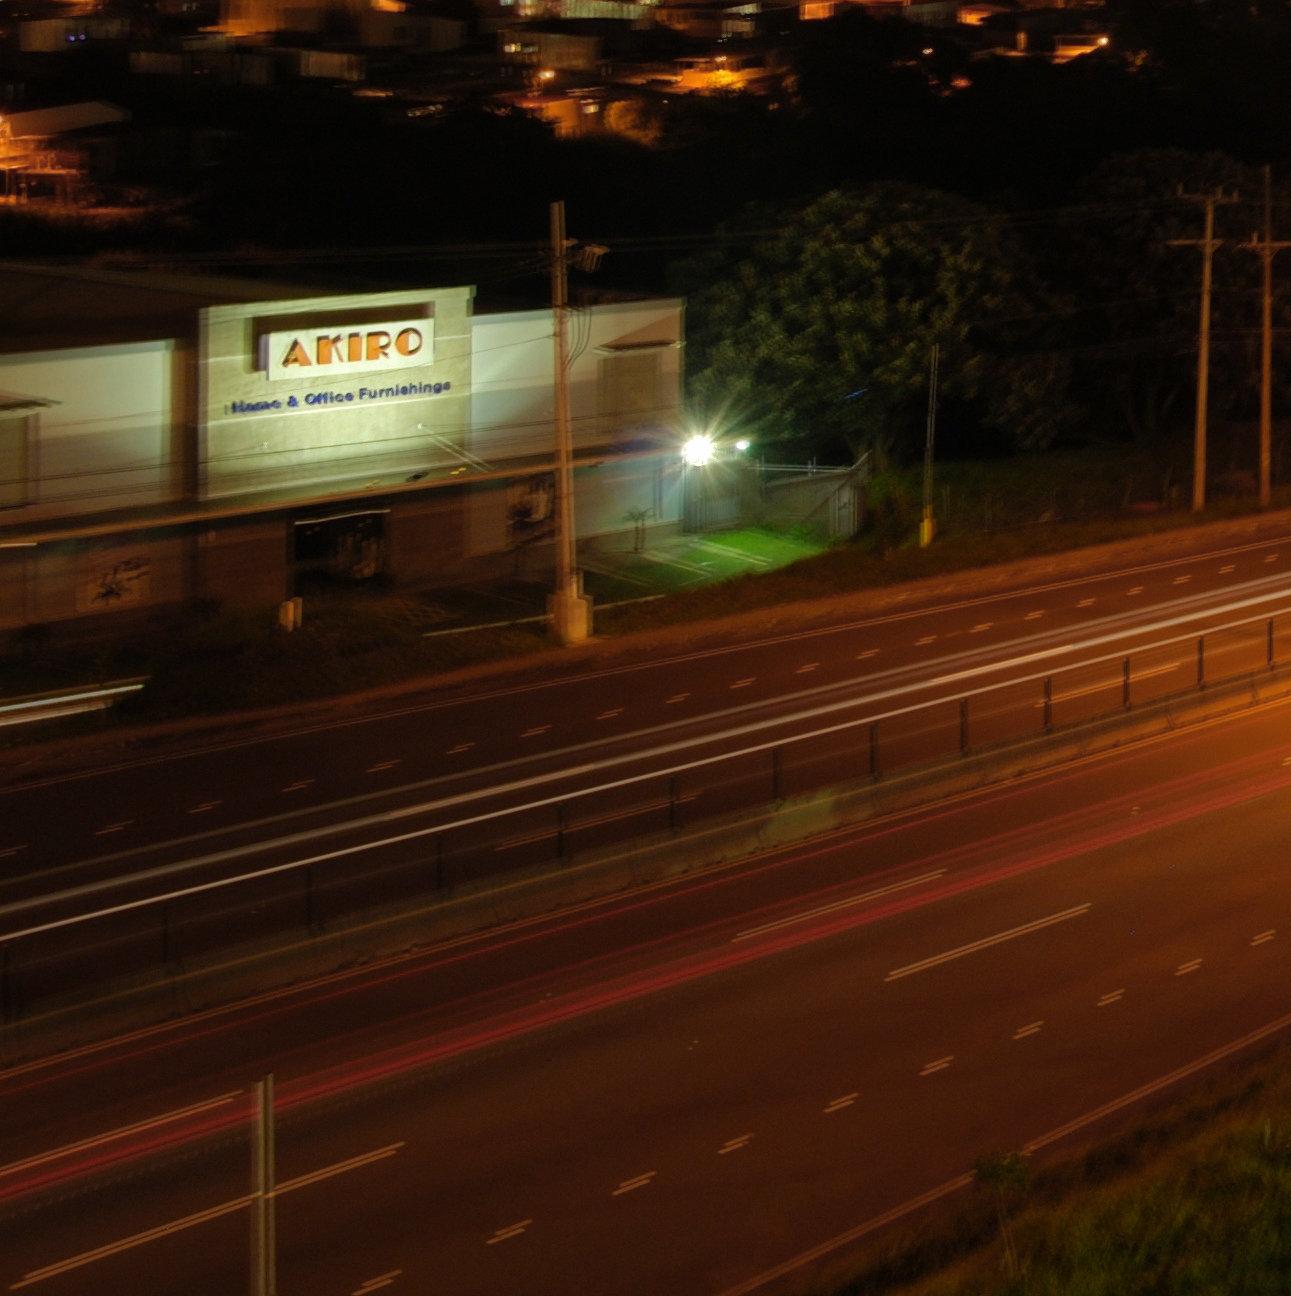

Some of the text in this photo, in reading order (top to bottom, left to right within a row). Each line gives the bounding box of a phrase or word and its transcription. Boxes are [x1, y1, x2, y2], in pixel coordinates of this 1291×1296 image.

[281, 327, 423, 368] AKIRO
[287, 395, 298, 408] &
[304, 391, 354, 406] Office
[358, 379, 451, 401] Furnishings
